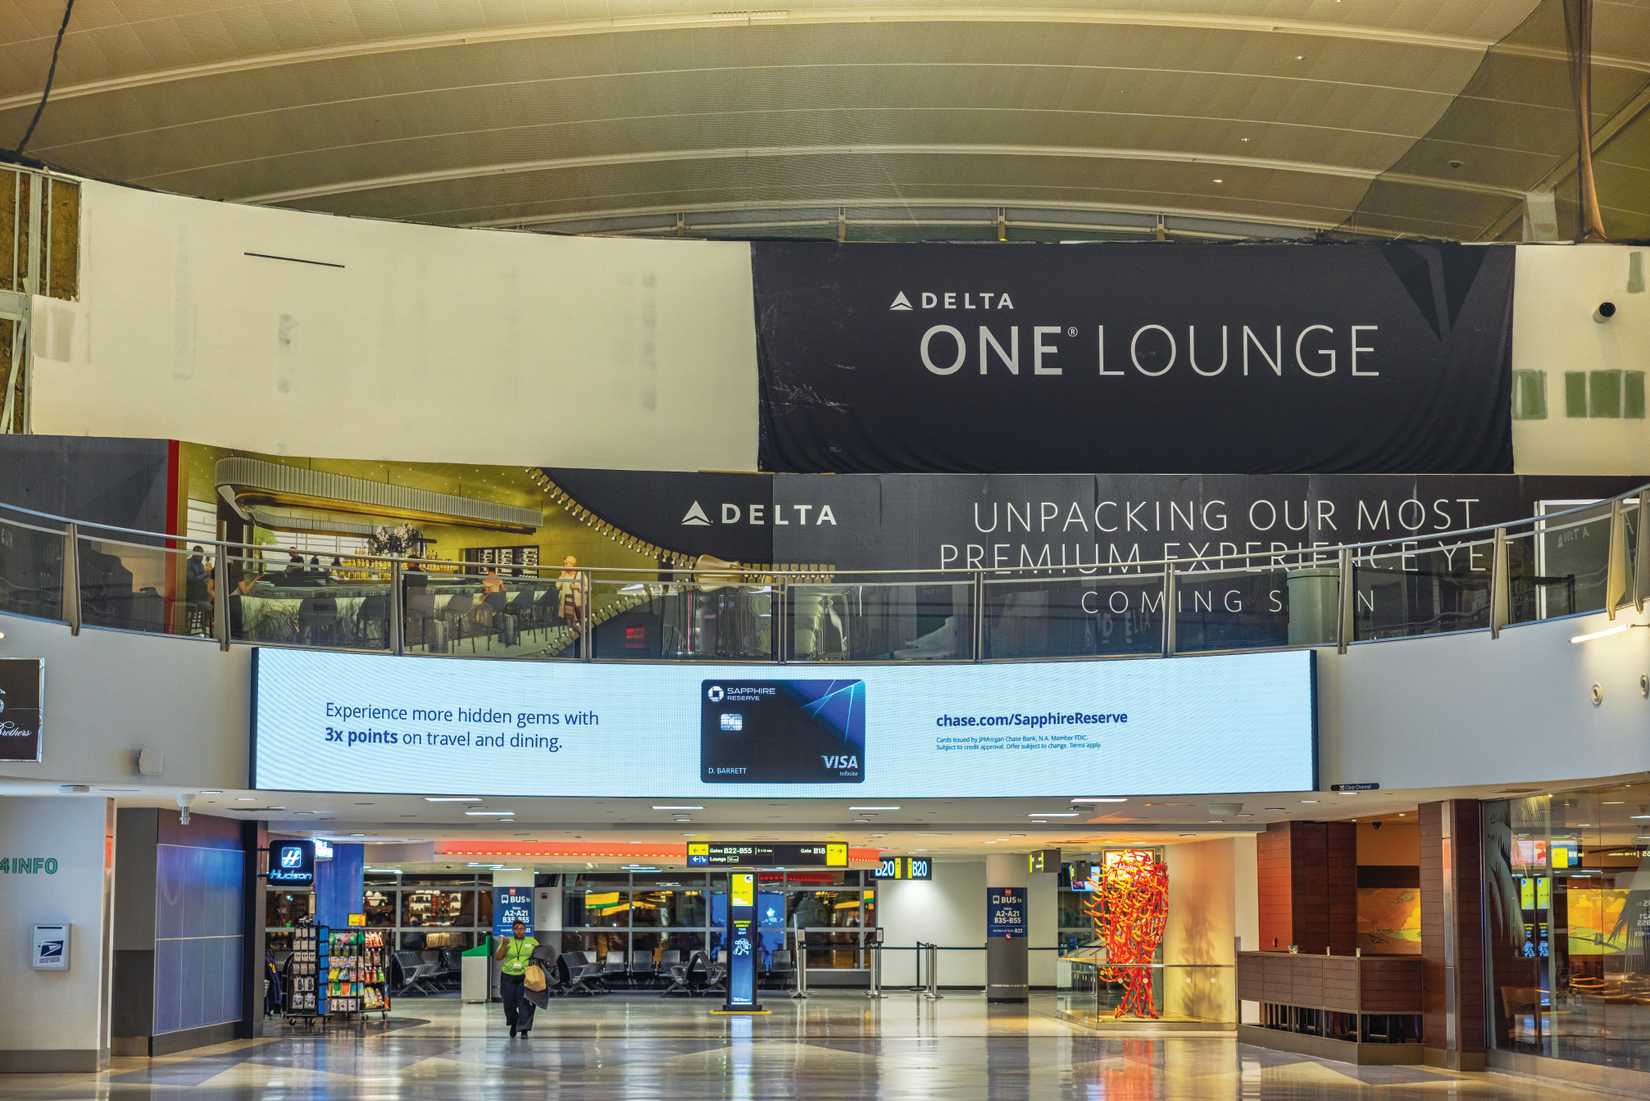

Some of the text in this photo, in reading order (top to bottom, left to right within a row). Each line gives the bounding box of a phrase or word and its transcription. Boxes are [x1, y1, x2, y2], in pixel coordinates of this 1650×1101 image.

[921, 292, 1014, 309] DELTA
[1099, 323, 1380, 377] LOUNGE
[722, 503, 837, 525] DELTA
[973, 499, 1479, 533] UNPACKING OUR MOST
[940, 543, 1141, 574] PREMIUM
[1081, 589, 1375, 614] COMING SN
[727, 687, 776, 695] SAPPHIRE
[325, 702, 600, 728] Experience more hidden gems with
[936, 713, 1128, 728] chase.com/SapphireReserve
[325, 727, 563, 752] 3x points on travel and dining.
[821, 755, 858, 769] VISA
[708, 767, 747, 775] D. BARRETT
[270, 868, 313, 880] Hudson
[912, 860, 928, 876] B20
[510, 896, 526, 904] BUS
[1001, 896, 1017, 904] BUS
[504, 909, 528, 917] A2-A21
